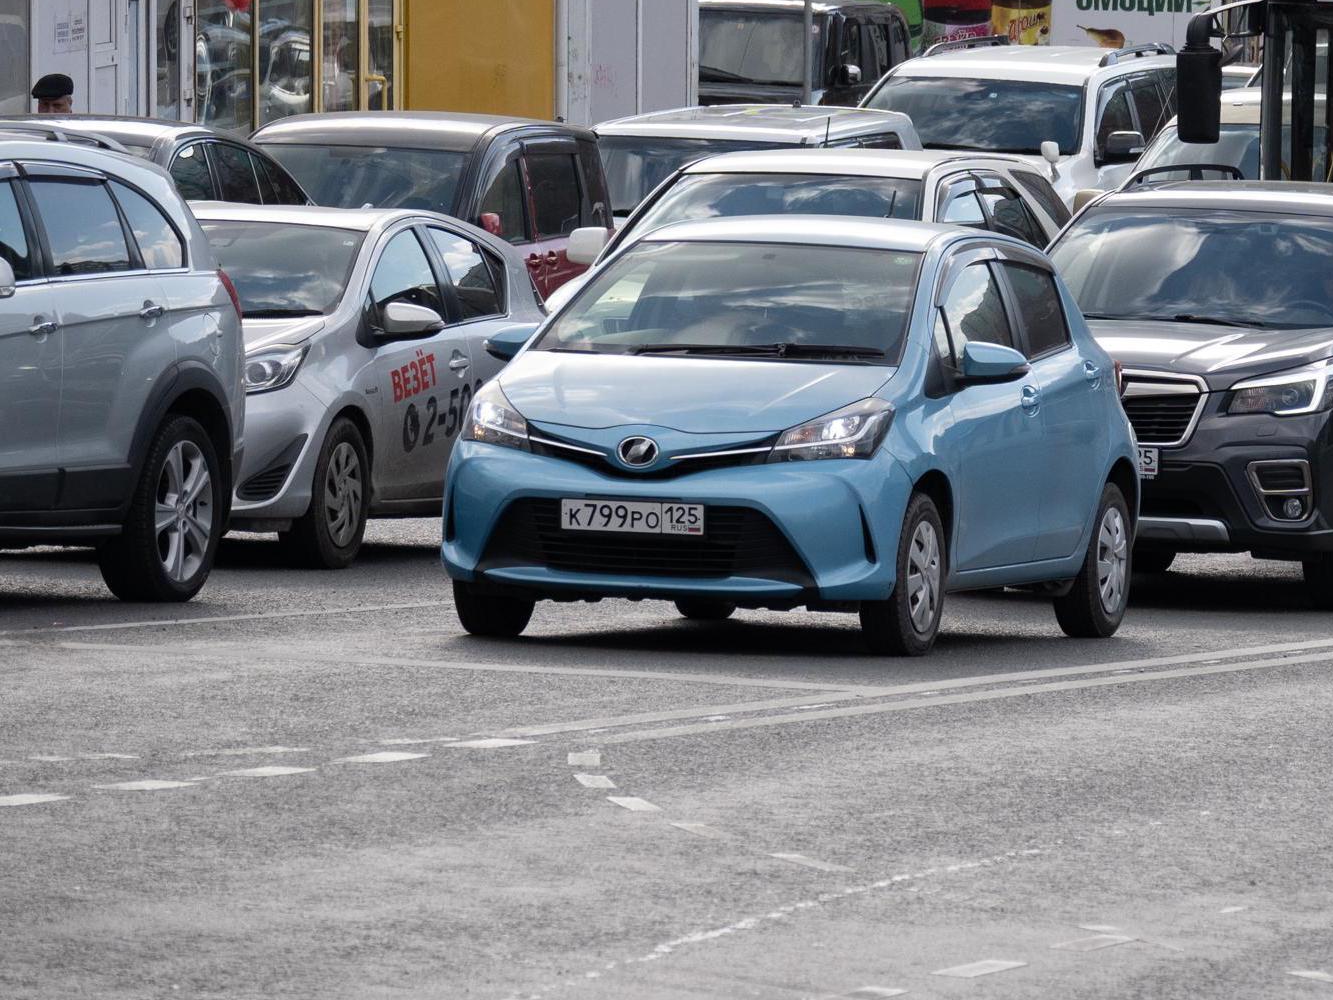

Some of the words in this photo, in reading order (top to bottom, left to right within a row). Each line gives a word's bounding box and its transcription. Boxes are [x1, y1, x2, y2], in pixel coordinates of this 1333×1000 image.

[390, 348, 436, 404] ВЕЗЁТ
[422, 378, 483, 447] 2-50
[569, 503, 660, 529] К799РО
[664, 505, 699, 524] 125
[670, 524, 688, 532] RUS
